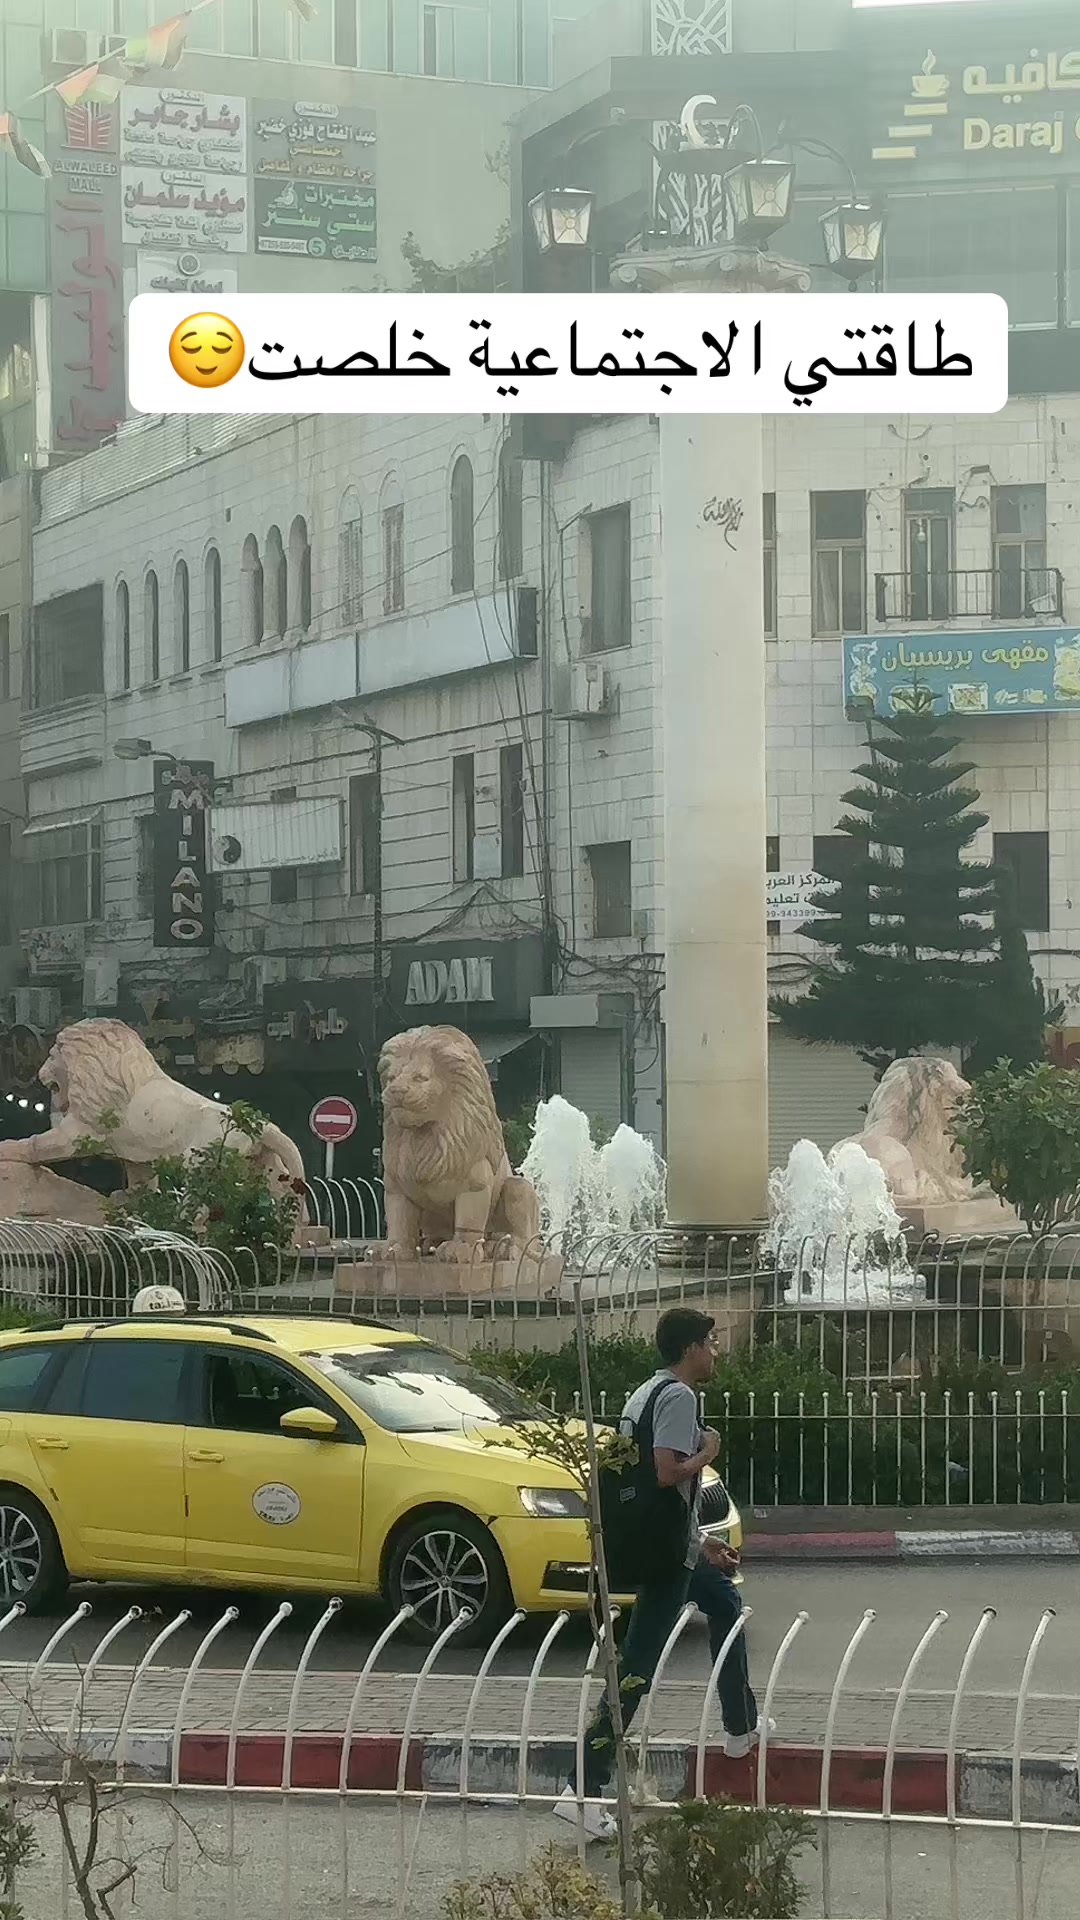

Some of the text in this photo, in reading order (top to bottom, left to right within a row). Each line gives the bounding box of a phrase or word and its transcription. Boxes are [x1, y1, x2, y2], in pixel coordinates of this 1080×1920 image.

[190, 104, 241, 137] بشار
[963, 110, 1065, 155] Daraj
[55, 160, 118, 175] ALWALEED
[70, 175, 103, 194] MALL
[304, 184, 376, 210] مختبرات
[981, 639, 1049, 670] مقهى
[167, 788, 207, 940] MILANO
